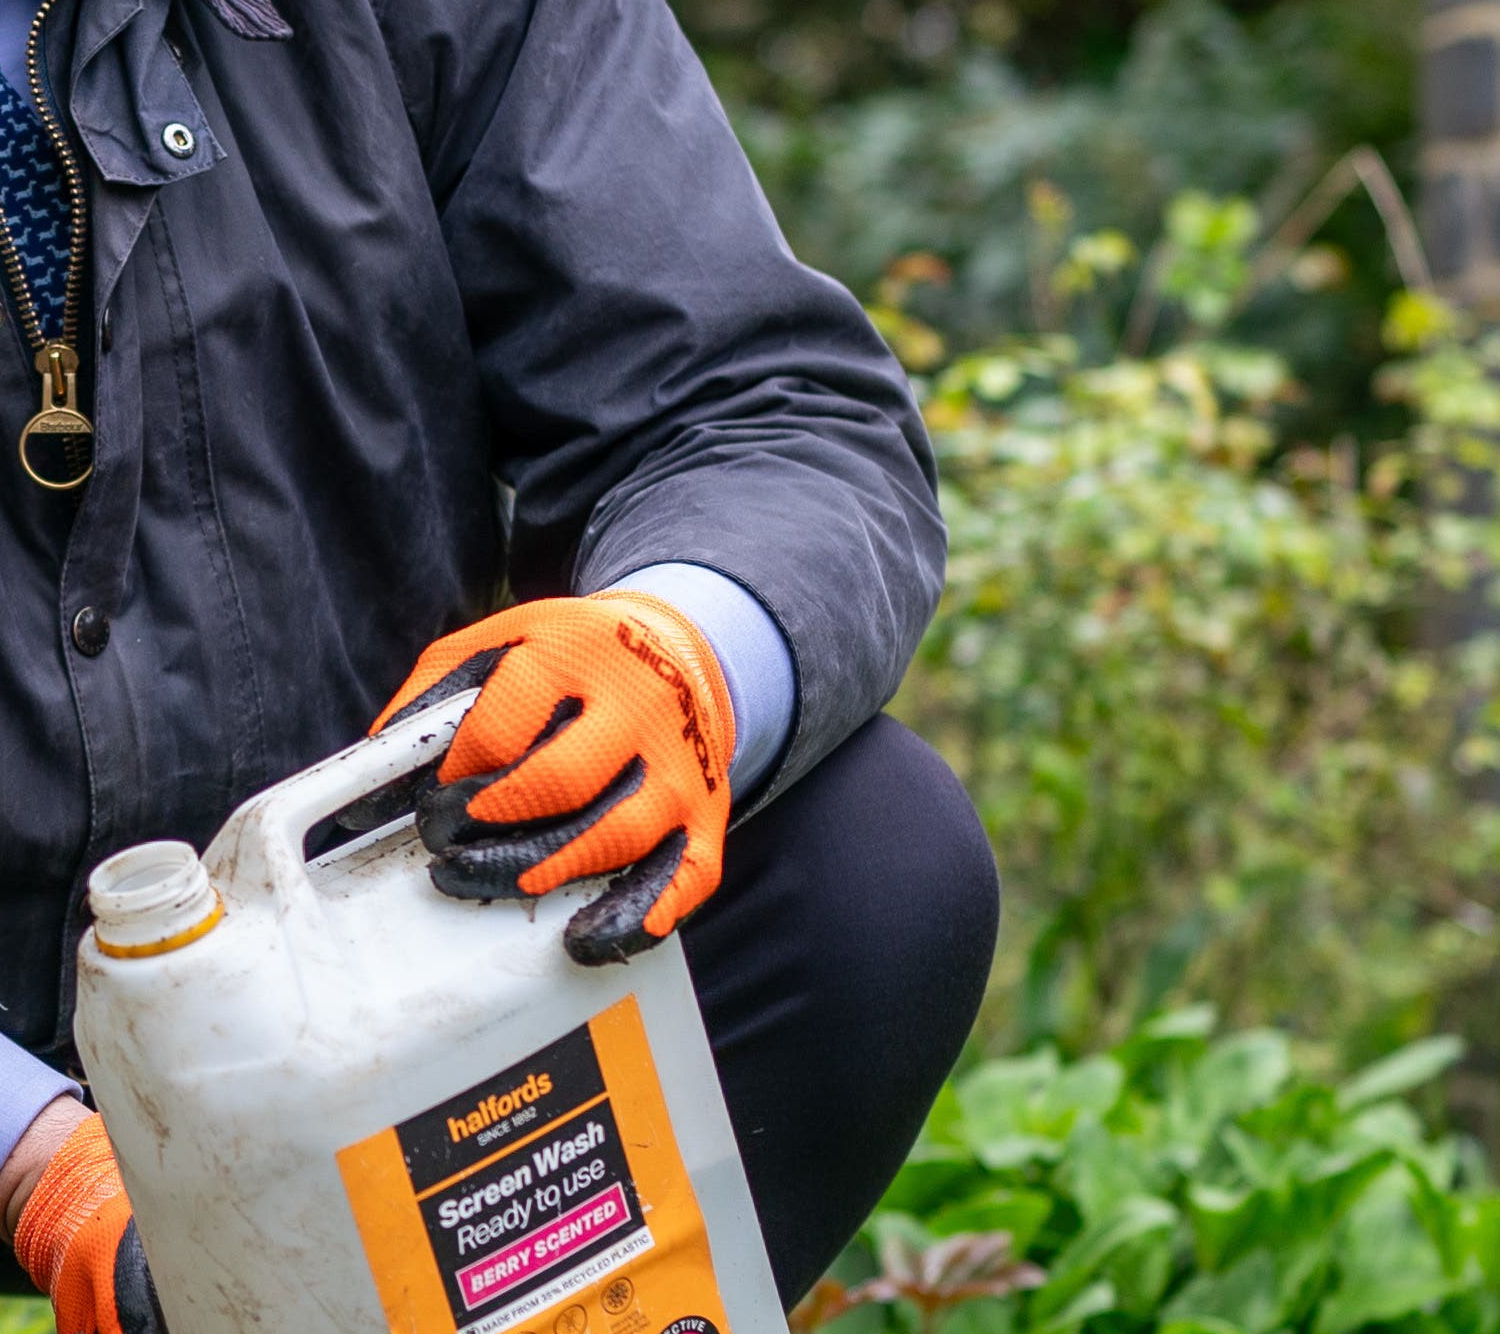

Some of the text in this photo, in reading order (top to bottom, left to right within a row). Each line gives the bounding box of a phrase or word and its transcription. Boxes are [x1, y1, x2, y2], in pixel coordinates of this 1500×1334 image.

[447, 1072, 553, 1143] halfords
[476, 1119, 512, 1147] SINCE
[438, 1120, 606, 1229] Screen Wash
[457, 1158, 606, 1255] Ready to use
[470, 1199, 617, 1294] BERRY SCENTED
[482, 1312, 512, 1334] MADE
[511, 1297, 540, 1319] FROM
[561, 1256, 612, 1292] RECYCLED
[610, 1233, 650, 1263] PLASTIC
